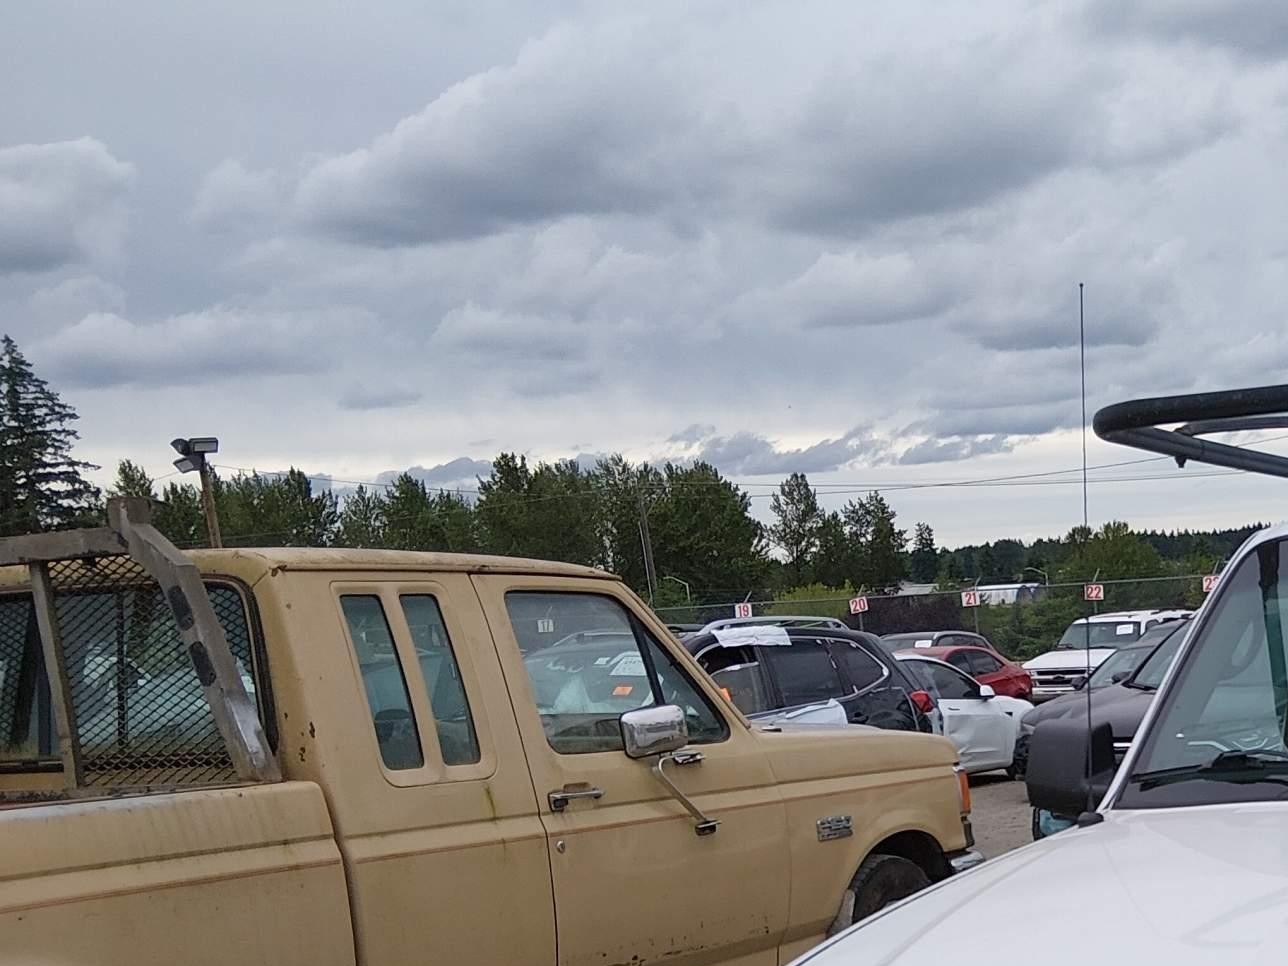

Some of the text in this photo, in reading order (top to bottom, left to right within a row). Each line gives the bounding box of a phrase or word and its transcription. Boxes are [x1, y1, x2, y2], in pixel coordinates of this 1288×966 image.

[965, 592, 977, 605] 21
[1087, 586, 1102, 599] 22
[737, 605, 749, 617] 19
[851, 599, 866, 612] 20
